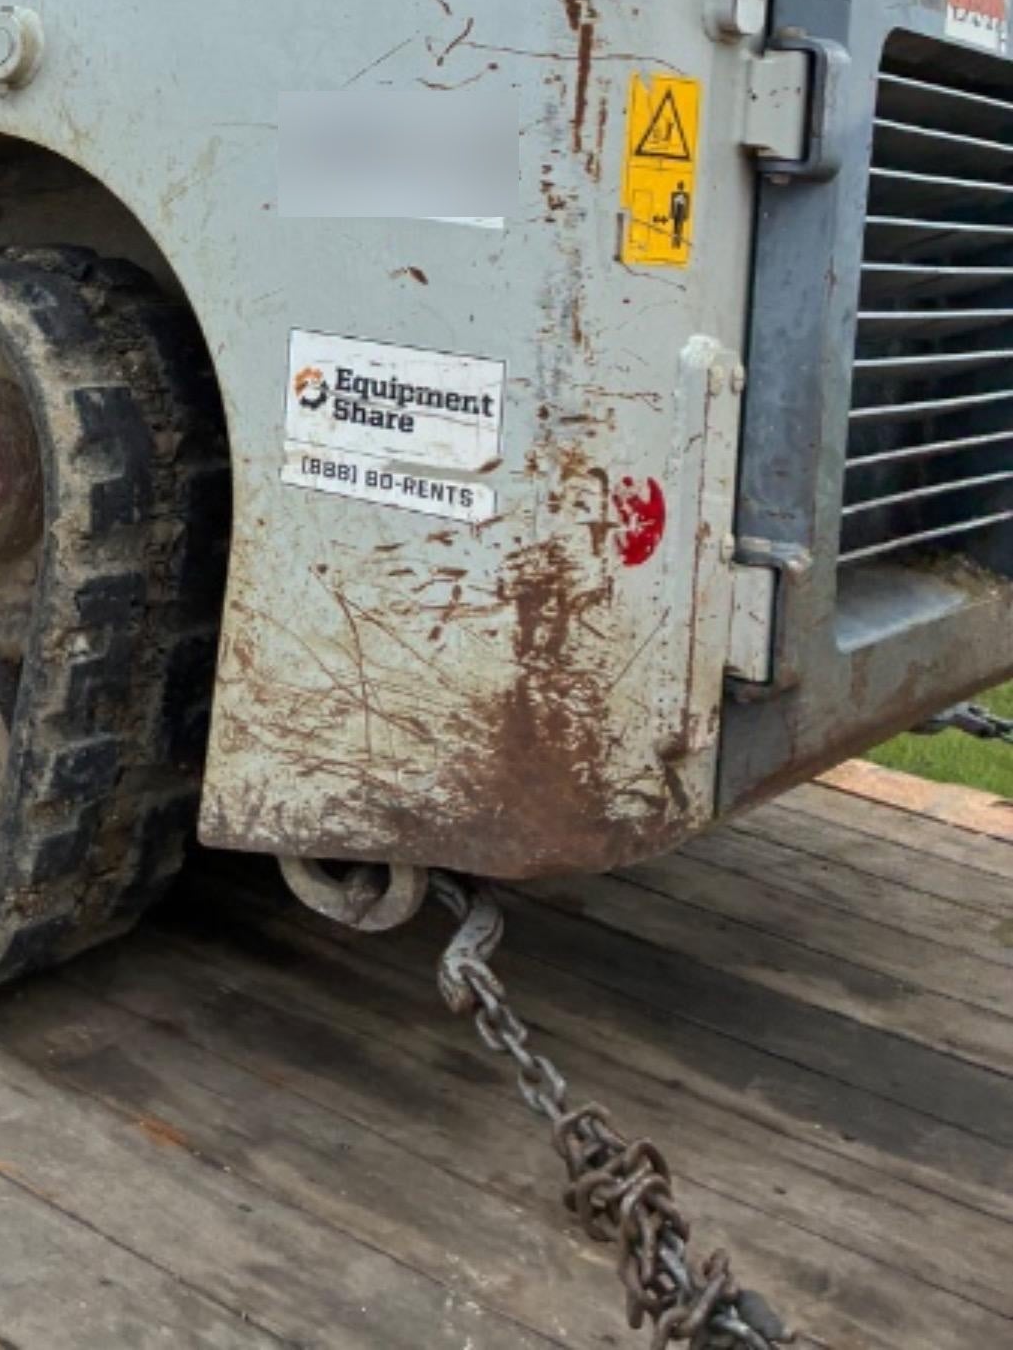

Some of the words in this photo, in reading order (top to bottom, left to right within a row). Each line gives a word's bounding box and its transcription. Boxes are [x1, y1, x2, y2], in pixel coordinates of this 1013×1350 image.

[335, 368, 494, 417] Equipment
[333, 400, 414, 432] Share
[365, 471, 474, 507] 80-RENTS
